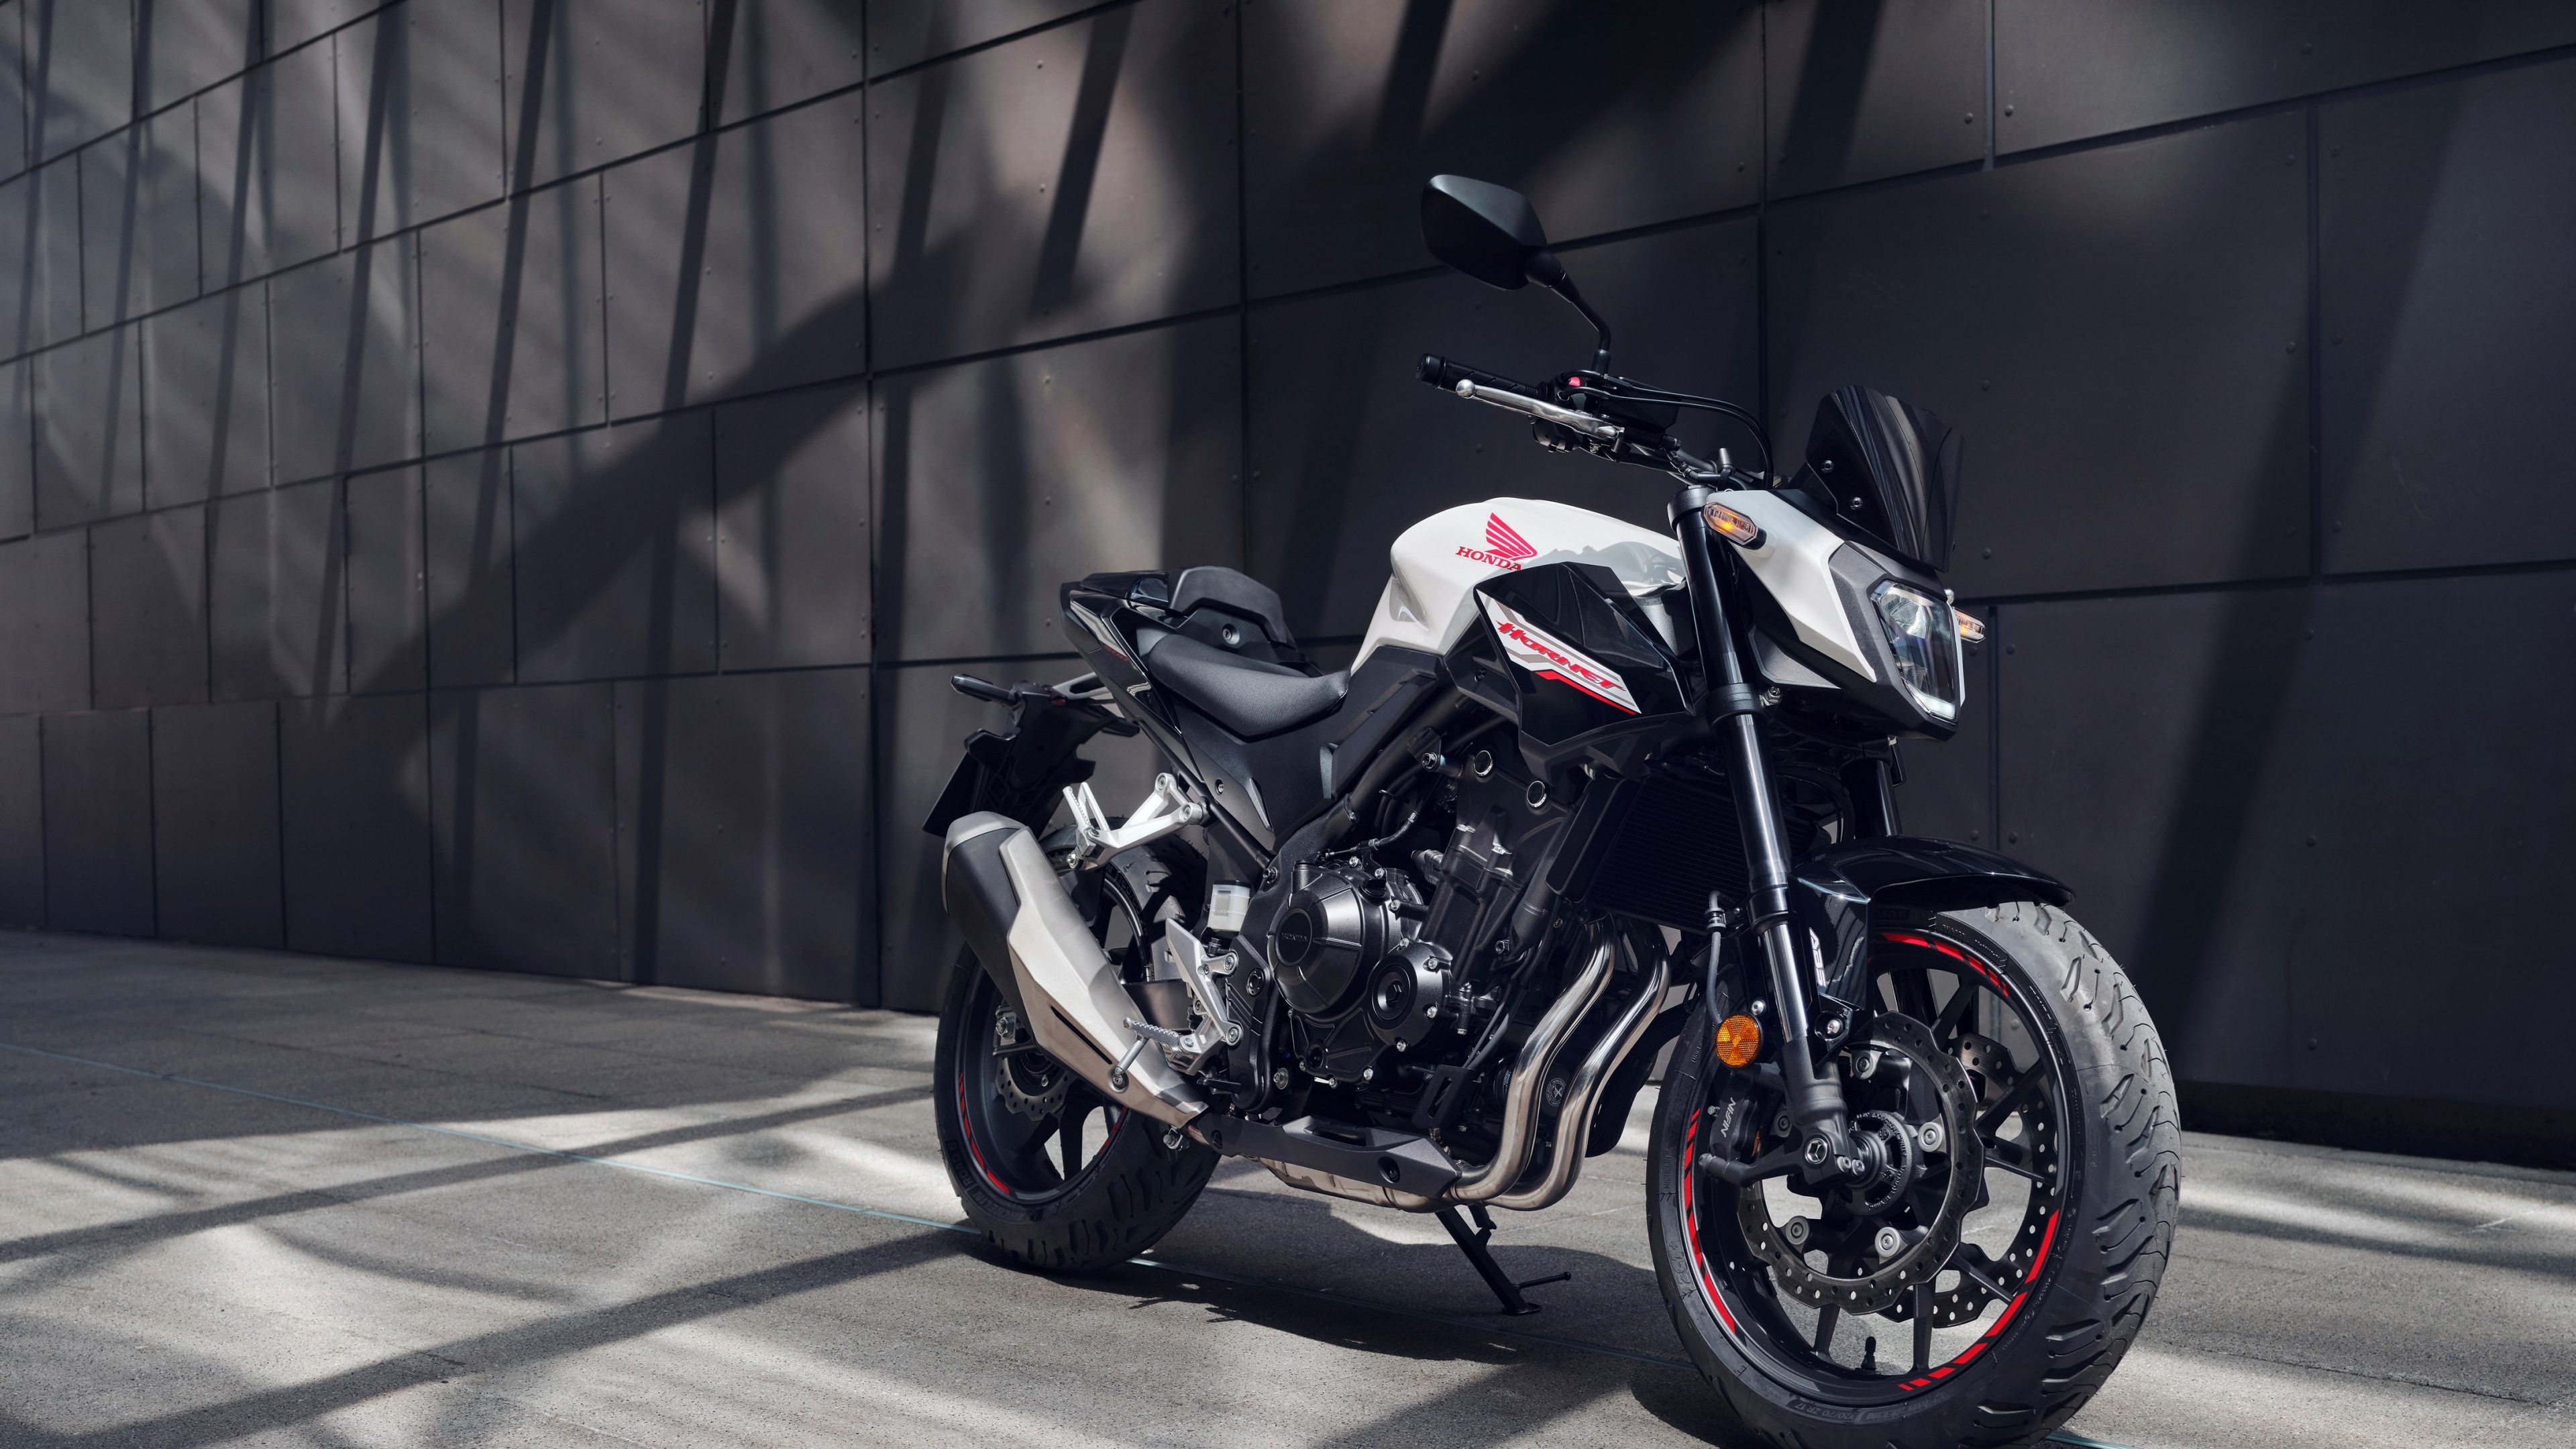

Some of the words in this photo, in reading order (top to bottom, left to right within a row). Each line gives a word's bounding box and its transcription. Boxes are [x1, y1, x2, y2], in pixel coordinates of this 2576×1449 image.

[1456, 546, 1521, 572] HONDA
[1495, 620, 1626, 691] HORNET
[1809, 927, 1826, 987] ABS
[1721, 1097, 1736, 1138] NISSIN
[953, 1155, 973, 1187] ROAD
